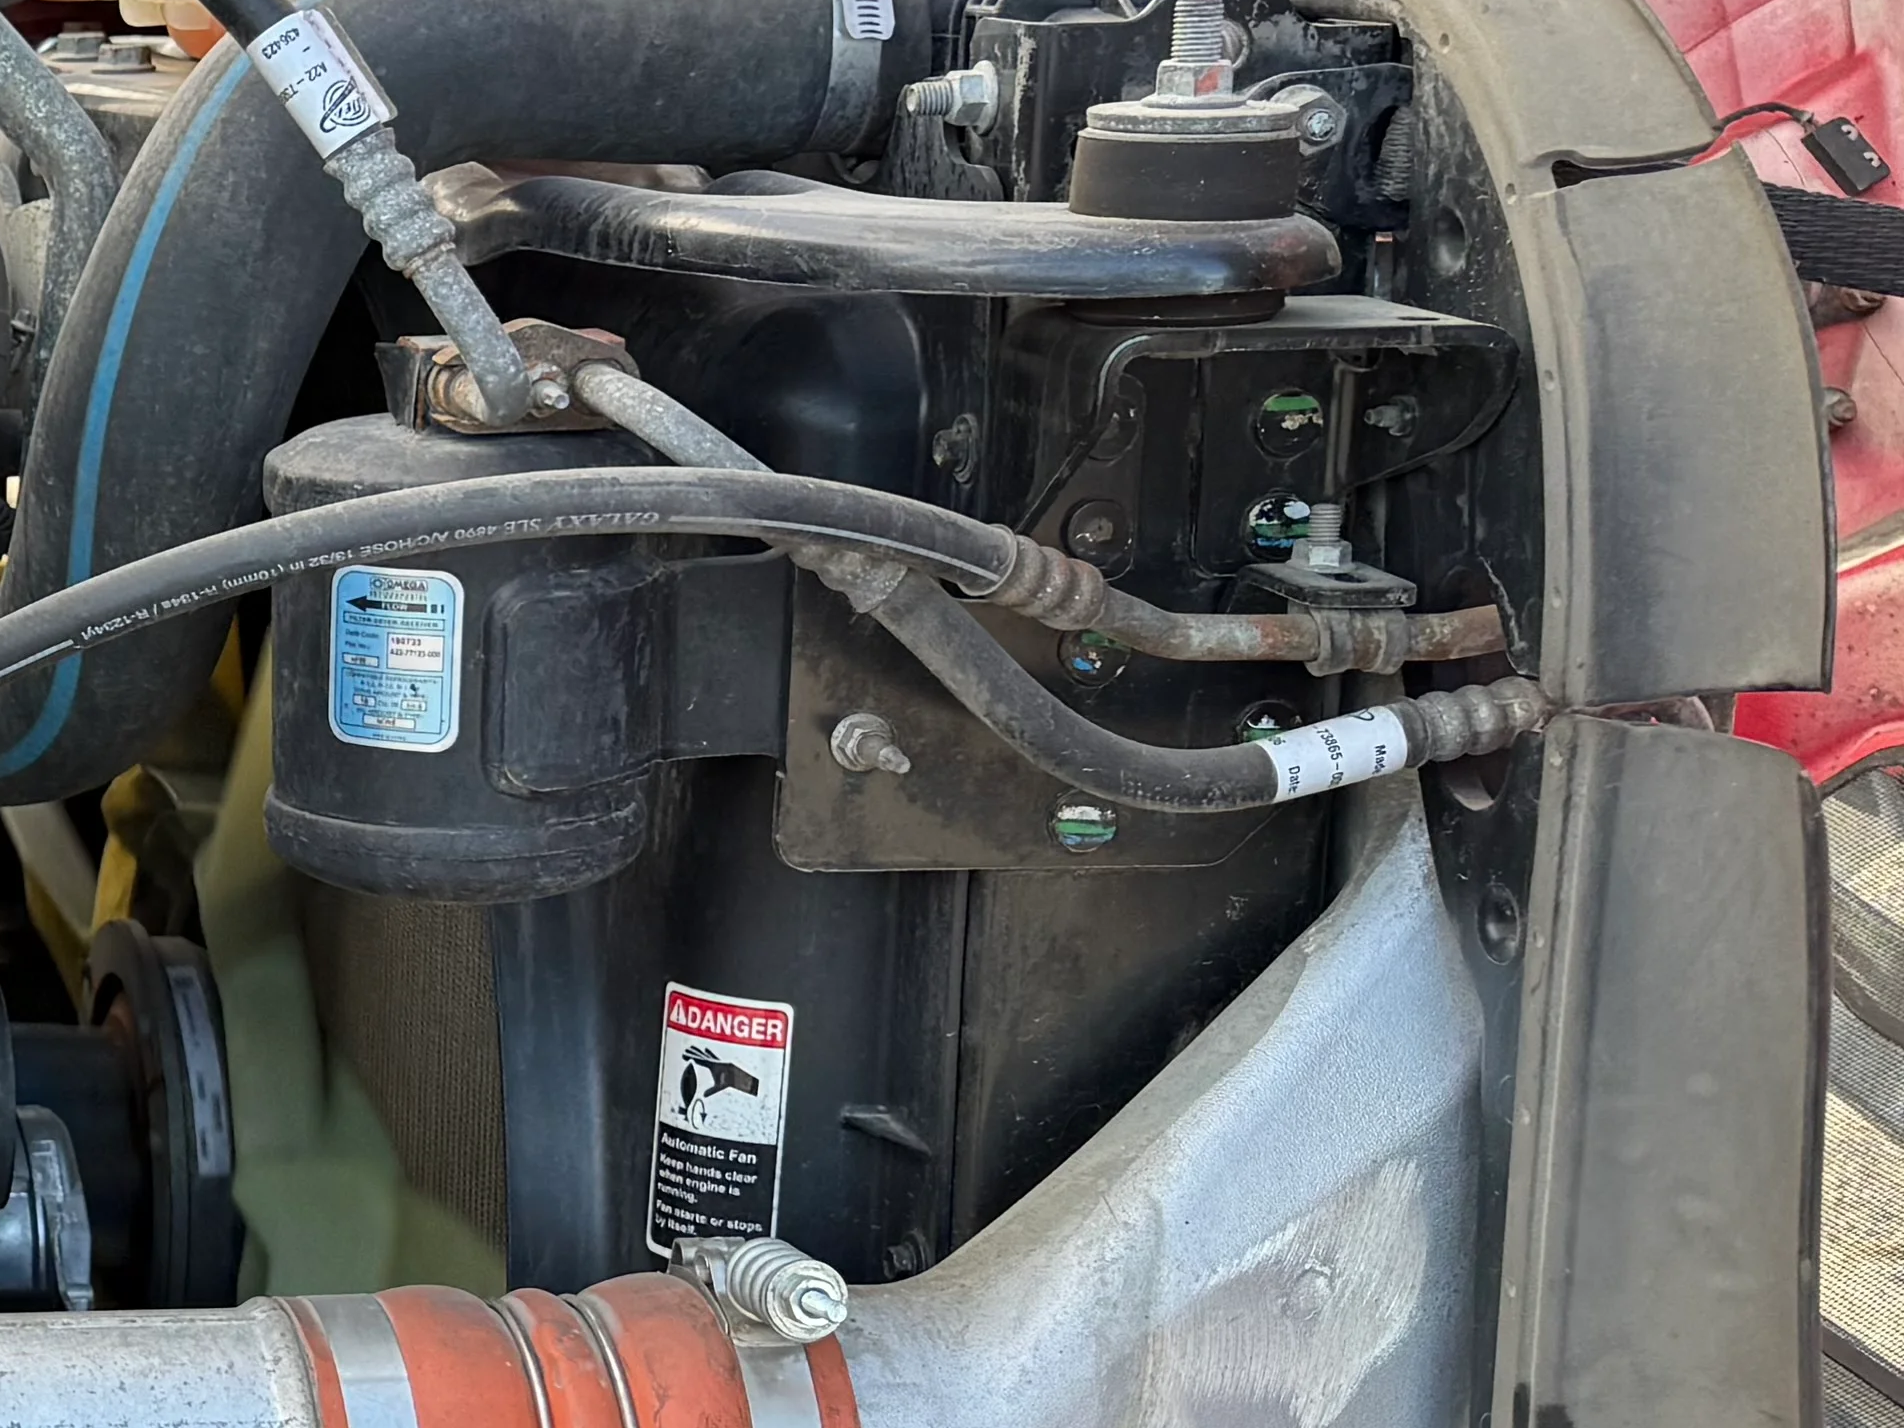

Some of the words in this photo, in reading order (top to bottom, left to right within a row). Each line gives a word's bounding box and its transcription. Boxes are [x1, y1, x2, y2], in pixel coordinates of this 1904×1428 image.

[547, 512, 659, 534] GALAXY
[309, 549, 353, 566] 13/32
[222, 562, 283, 590] (10mm)
[387, 578, 427, 592] OMEGA
[381, 601, 409, 612] FLOW
[688, 1007, 783, 1041] DANGER
[661, 1132, 726, 1161] Automatic
[729, 1149, 757, 1165] Fan
[659, 1153, 684, 1171] Keep
[686, 1160, 722, 1180] hands
[725, 1169, 758, 1184] clear
[659, 1168, 683, 1185] when
[685, 1174, 726, 1196] engine
[728, 1183, 741, 1196] is
[657, 1181, 698, 1204] running.
[656, 1199, 673, 1215] Fan
[674, 1204, 707, 1225] starts
[709, 1215, 724, 1228] or
[726, 1218, 763, 1234] stops
